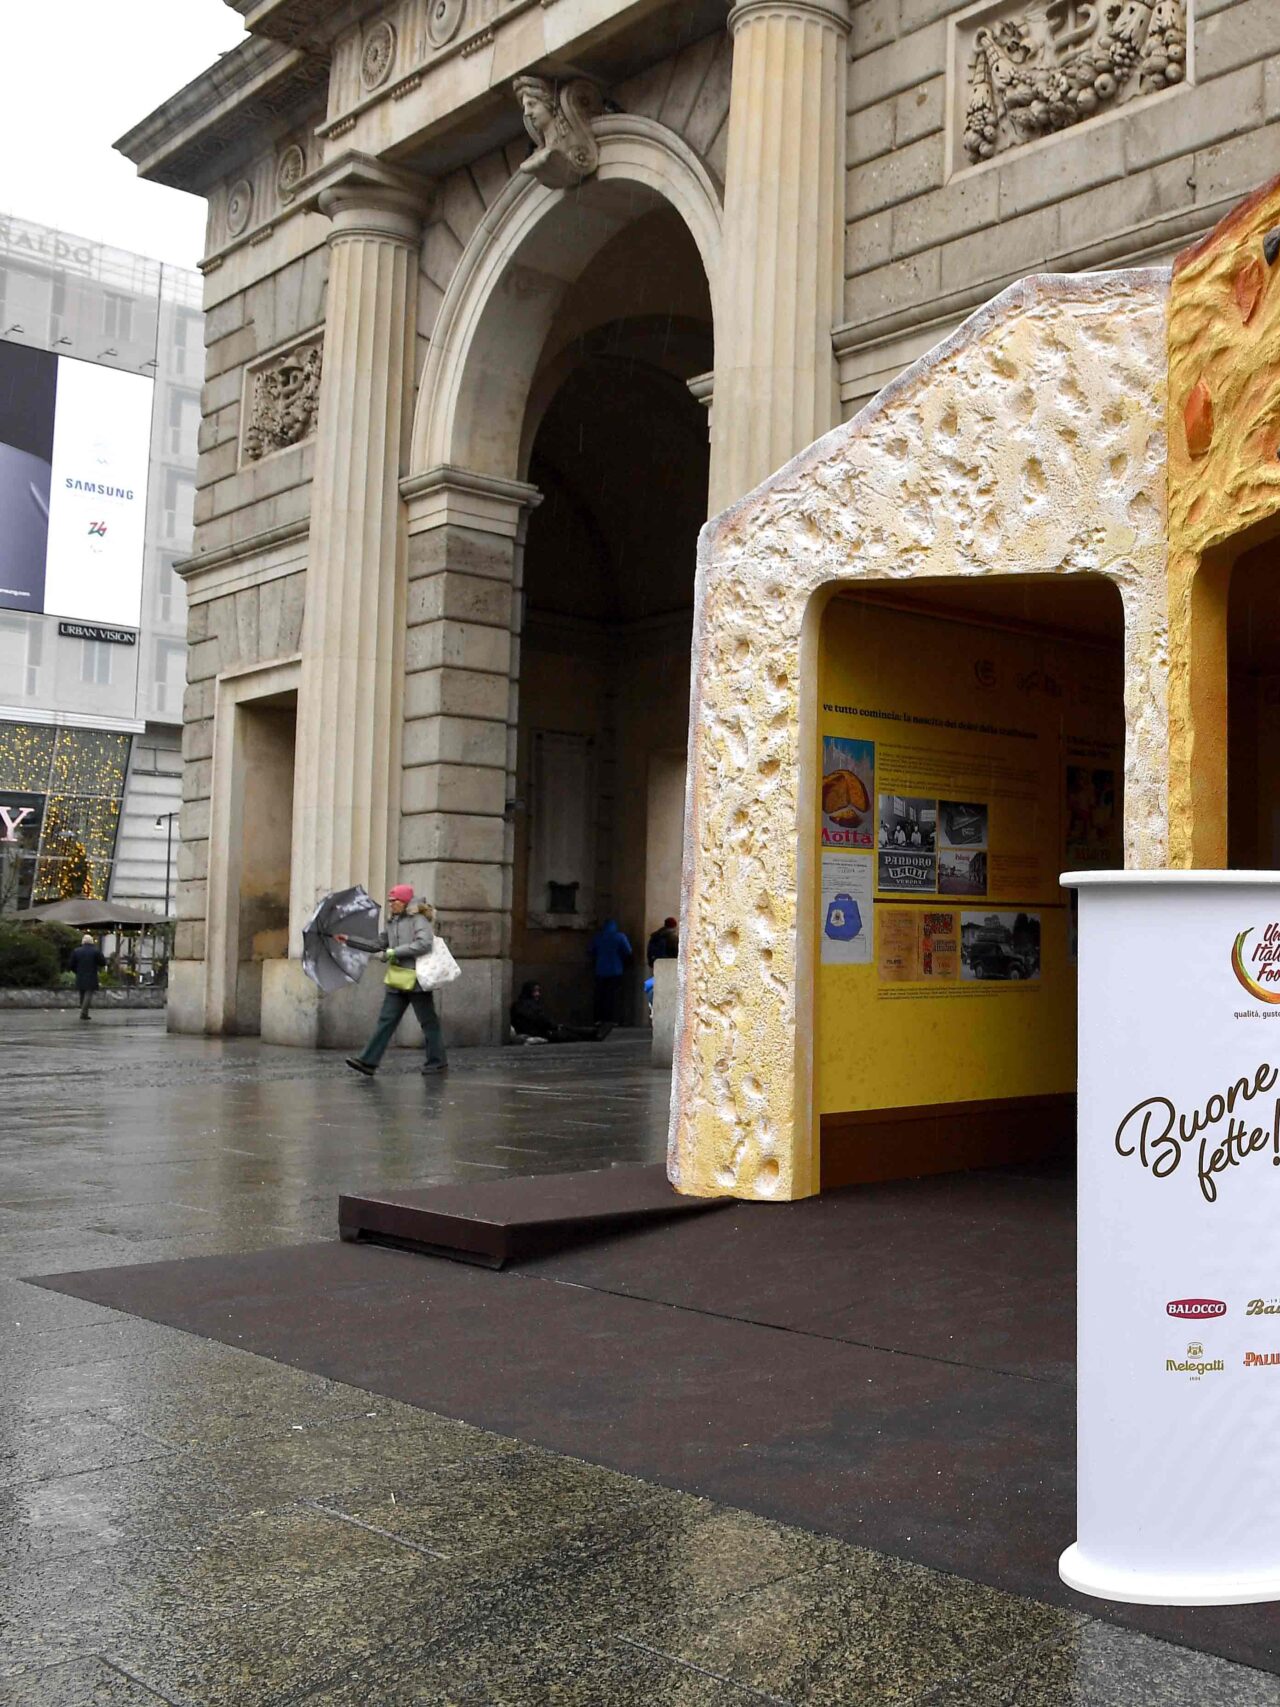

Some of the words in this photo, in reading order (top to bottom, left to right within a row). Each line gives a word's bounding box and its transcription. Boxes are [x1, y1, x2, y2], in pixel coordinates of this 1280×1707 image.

[65, 477, 134, 501] SAMSUNG
[60, 624, 97, 637] URBAN
[99, 629, 135, 643] VISION
[834, 704, 858, 715] tutto
[859, 708, 902, 720] comincia:
[903, 712, 911, 721] la
[0, 806, 35, 842] Y
[884, 855, 932, 868] PANDORO
[1234, 1010, 1261, 1019] qualità,
[1114, 1063, 1279, 1178] Buone
[1168, 1303, 1224, 1314] BALOCCO
[1166, 1359, 1224, 1375] Melegatti
